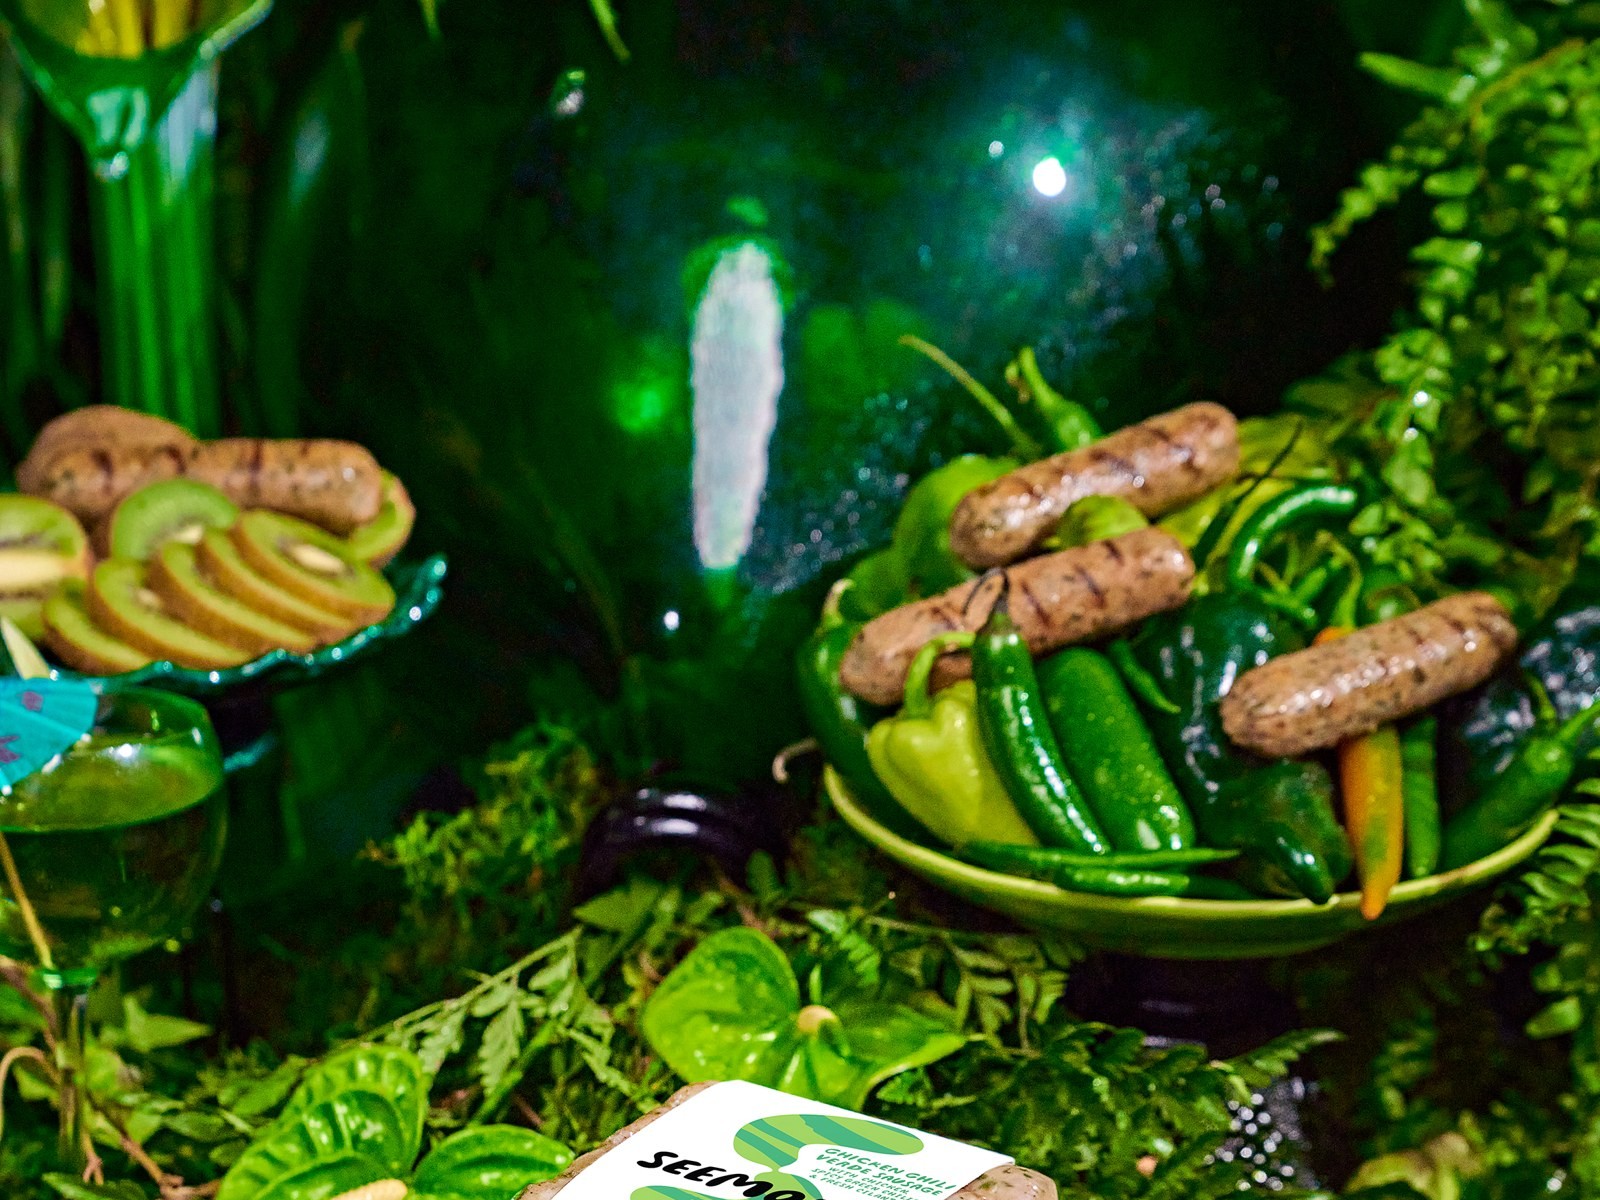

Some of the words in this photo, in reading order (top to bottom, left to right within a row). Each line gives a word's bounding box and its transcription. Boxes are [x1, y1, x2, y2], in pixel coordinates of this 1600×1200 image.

[811, 1168, 844, 1180] SPICY
[844, 1178, 881, 1191] GREEN
[816, 1154, 872, 1174] VERDE
[872, 1172, 943, 1196] SAUSAGE
[829, 1167, 858, 1179] WITH
[820, 1177, 855, 1190] FRESH
